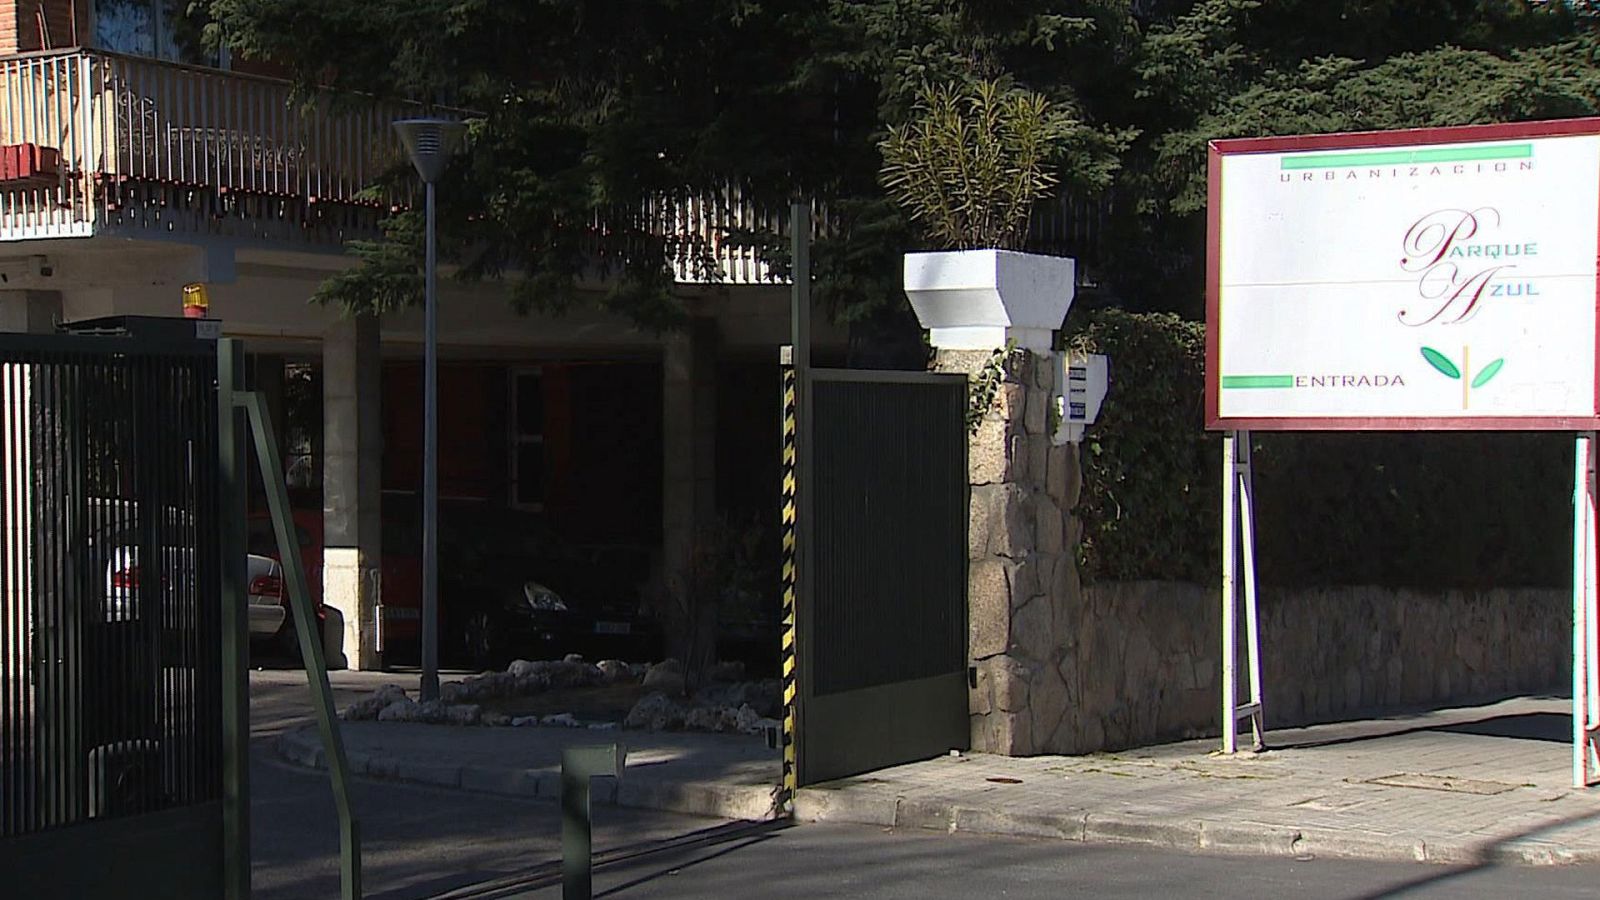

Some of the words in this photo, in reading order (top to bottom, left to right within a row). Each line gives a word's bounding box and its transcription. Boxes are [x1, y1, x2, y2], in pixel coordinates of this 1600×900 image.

[1280, 161, 1534, 182] URBANIZACION
[1399, 206, 1538, 273] PARQUE
[1397, 263, 1540, 328] AZUL
[1296, 375, 1406, 388] ENTRADA
